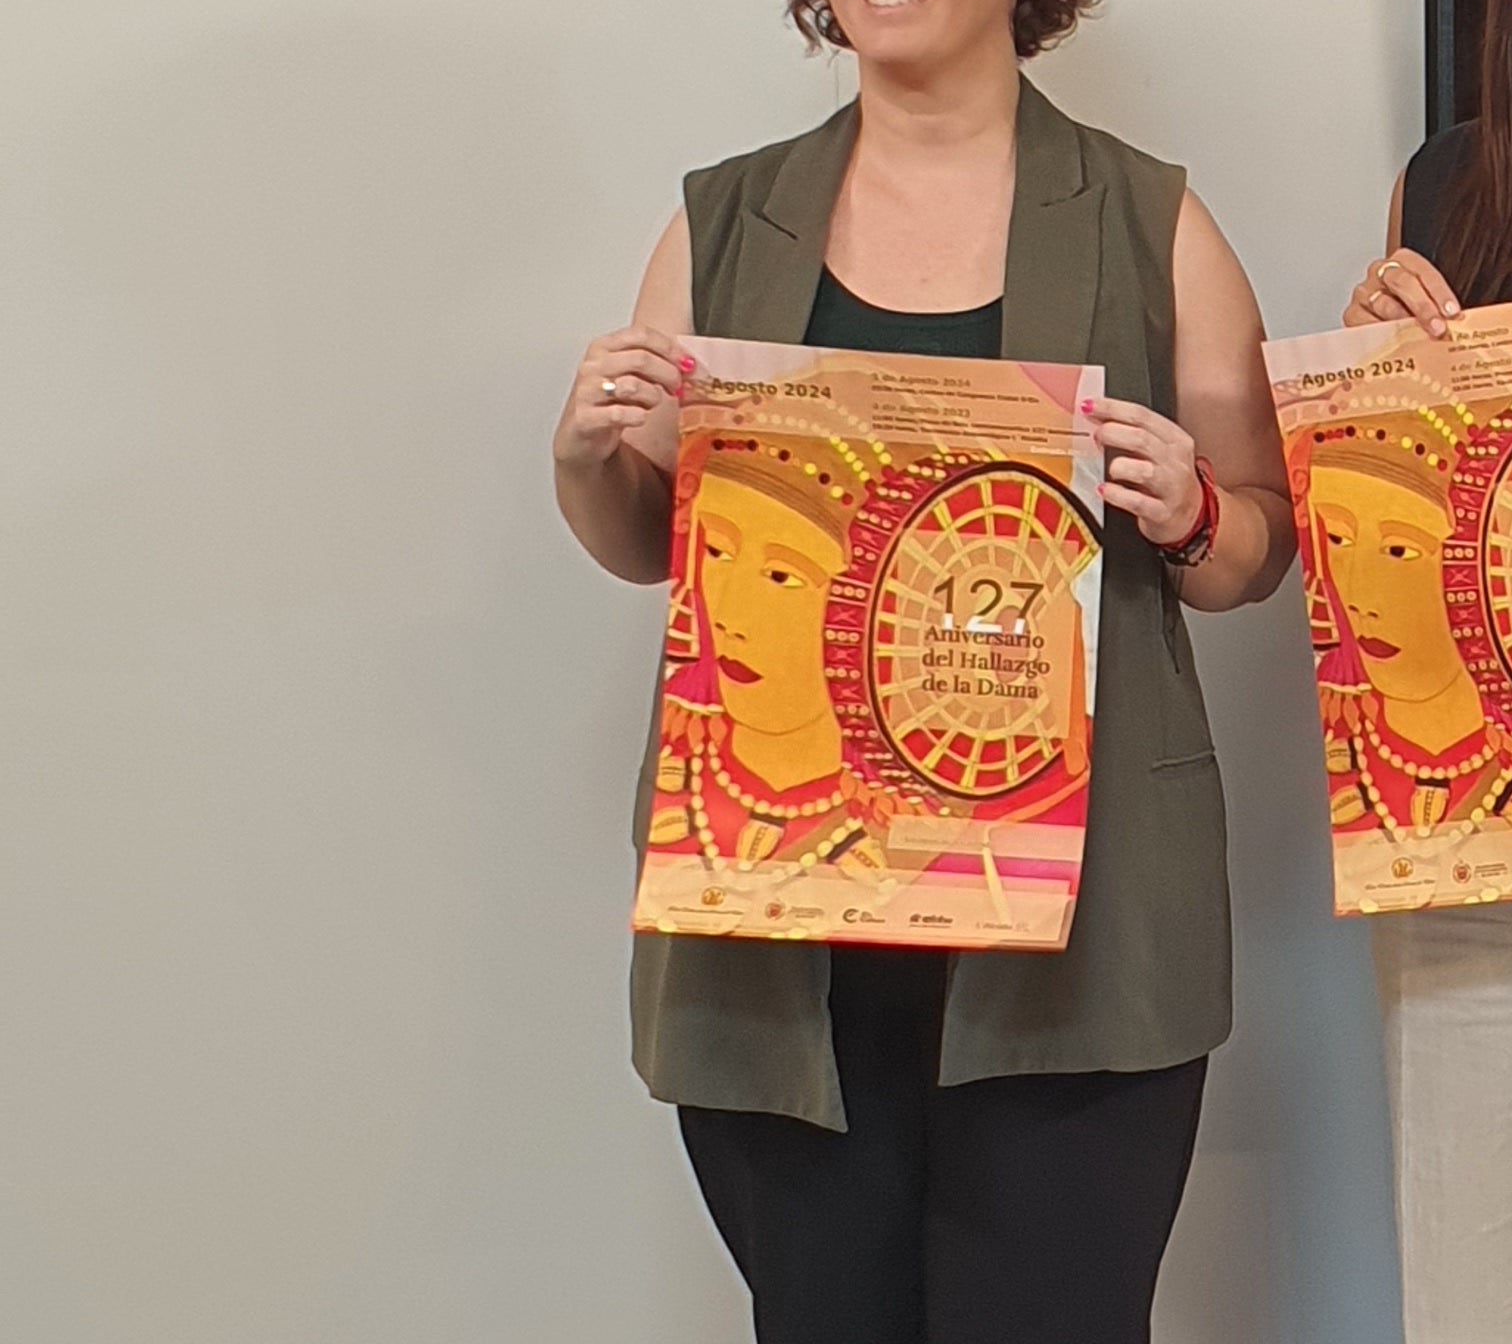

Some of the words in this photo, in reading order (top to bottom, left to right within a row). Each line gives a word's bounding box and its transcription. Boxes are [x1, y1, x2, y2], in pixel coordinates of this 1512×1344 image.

[1302, 367, 1365, 387] Agosto
[1371, 358, 1415, 376] 2024
[712, 378, 777, 395] Agosto
[784, 383, 831, 399] 2024
[934, 576, 1044, 635] 127
[924, 625, 1045, 649] Aniversario
[922, 648, 953, 667] del
[961, 651, 1050, 679] Hallazgo
[922, 673, 947, 692] de
[953, 675, 971, 694] la
[977, 678, 1039, 699] Dama
